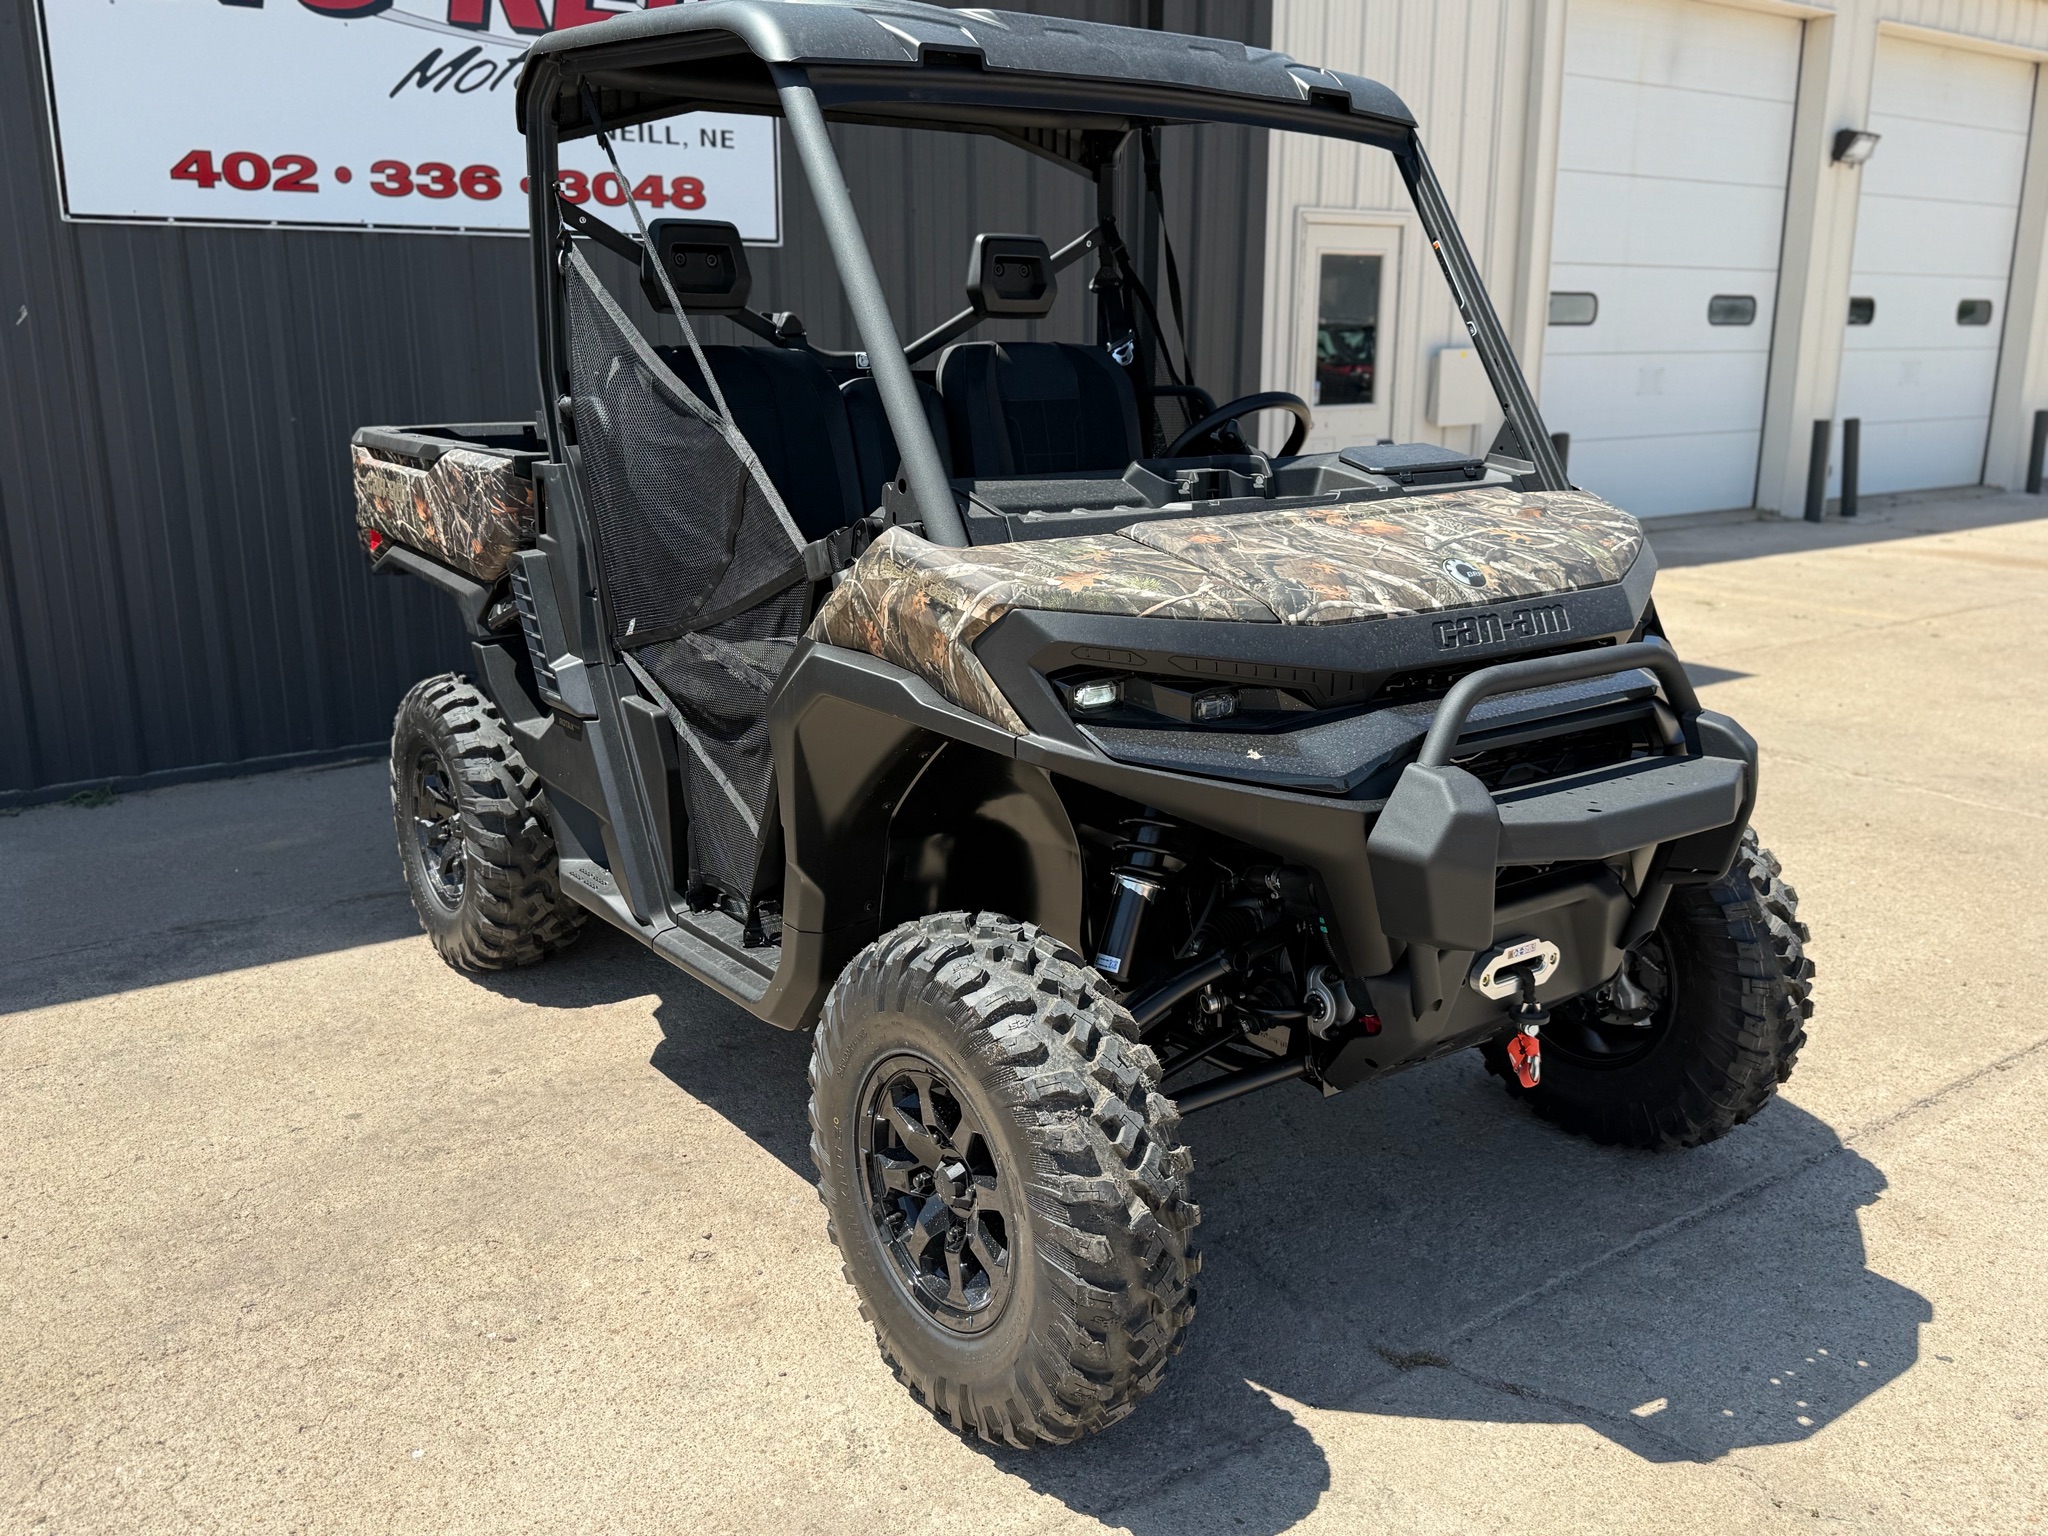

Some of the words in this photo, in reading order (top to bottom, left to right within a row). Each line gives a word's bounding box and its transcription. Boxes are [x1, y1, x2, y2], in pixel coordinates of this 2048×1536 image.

[389, 46, 531, 98] Mot
[700, 128, 735, 149] NE
[170, 149, 319, 194] 402
[370, 160, 502, 201] 336
[557, 169, 707, 210] 3048
[1431, 603, 1573, 651] can-am
